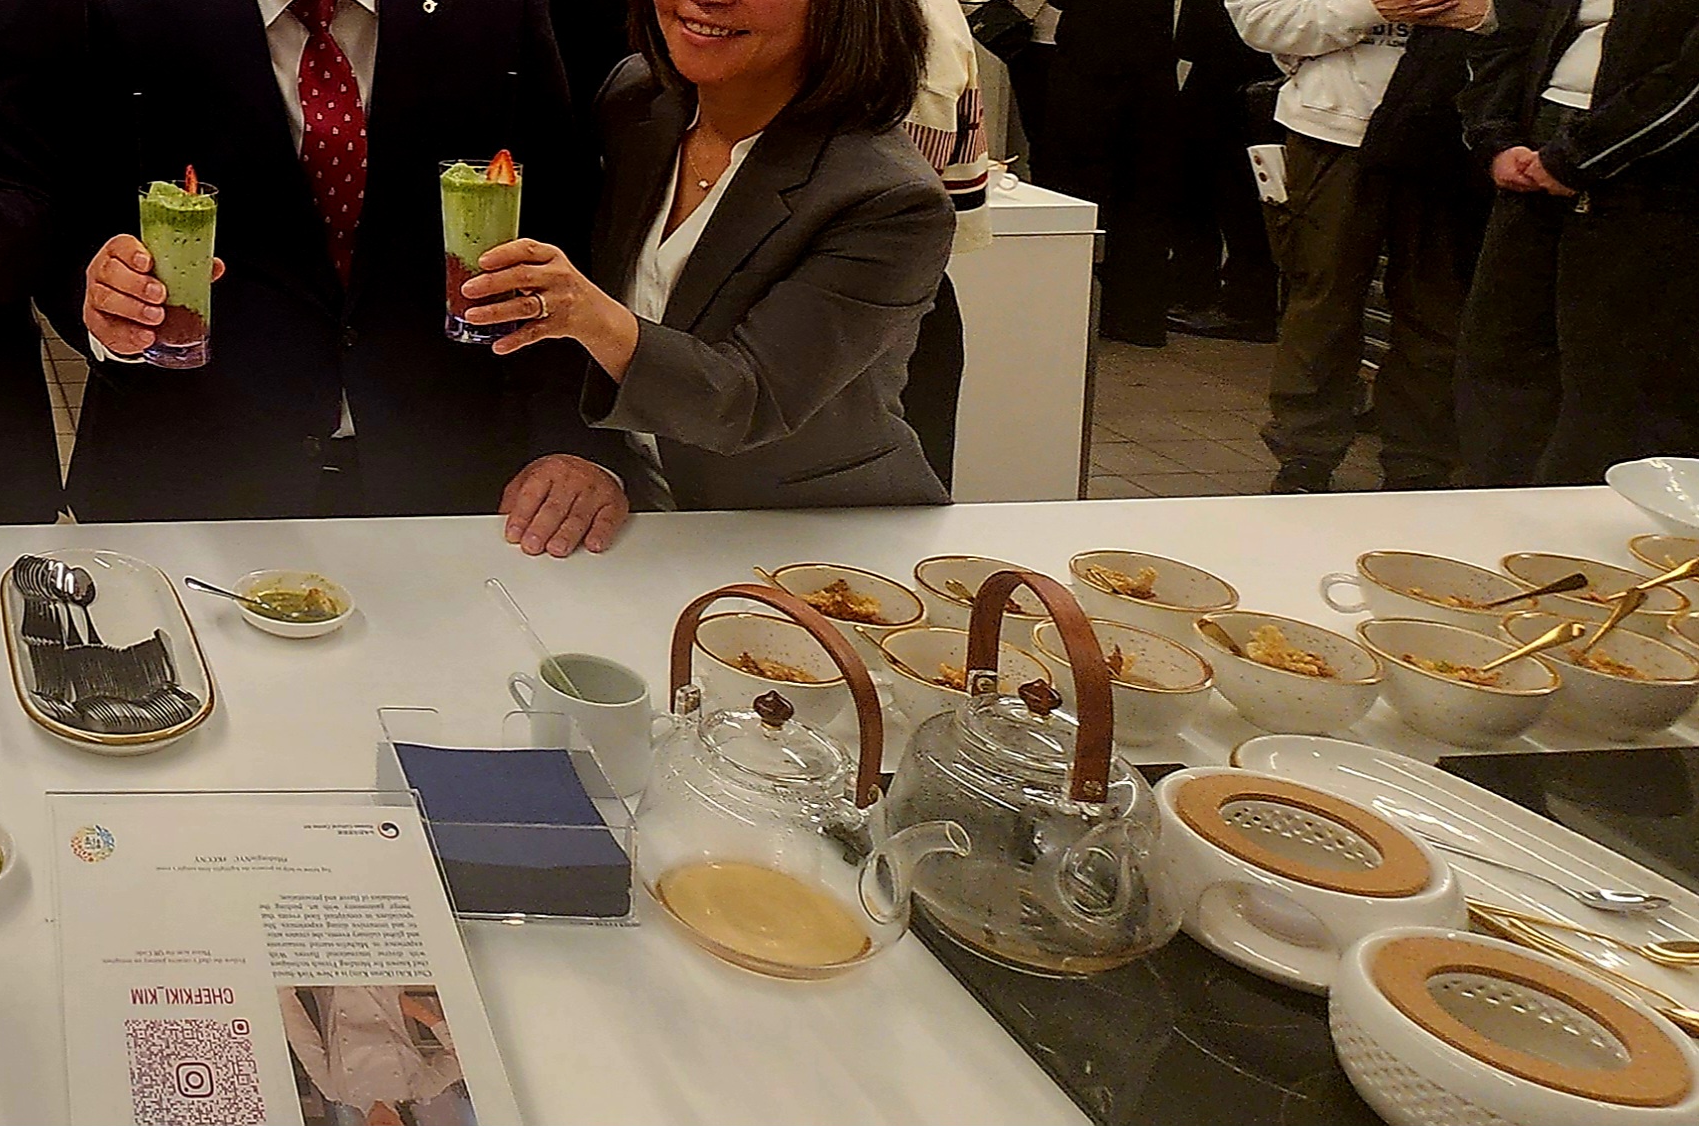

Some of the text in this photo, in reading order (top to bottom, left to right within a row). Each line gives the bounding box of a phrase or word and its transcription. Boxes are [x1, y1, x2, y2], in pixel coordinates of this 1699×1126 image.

[266, 941, 306, 949] restaurants
[384, 941, 423, 949] experience
[270, 960, 310, 968] techniques
[312, 960, 338, 968] French
[340, 960, 372, 968] blending
[386, 960, 412, 968] known
[316, 970, 333, 978] New
[130, 986, 234, 1004] CHEFKIKI_KIM
